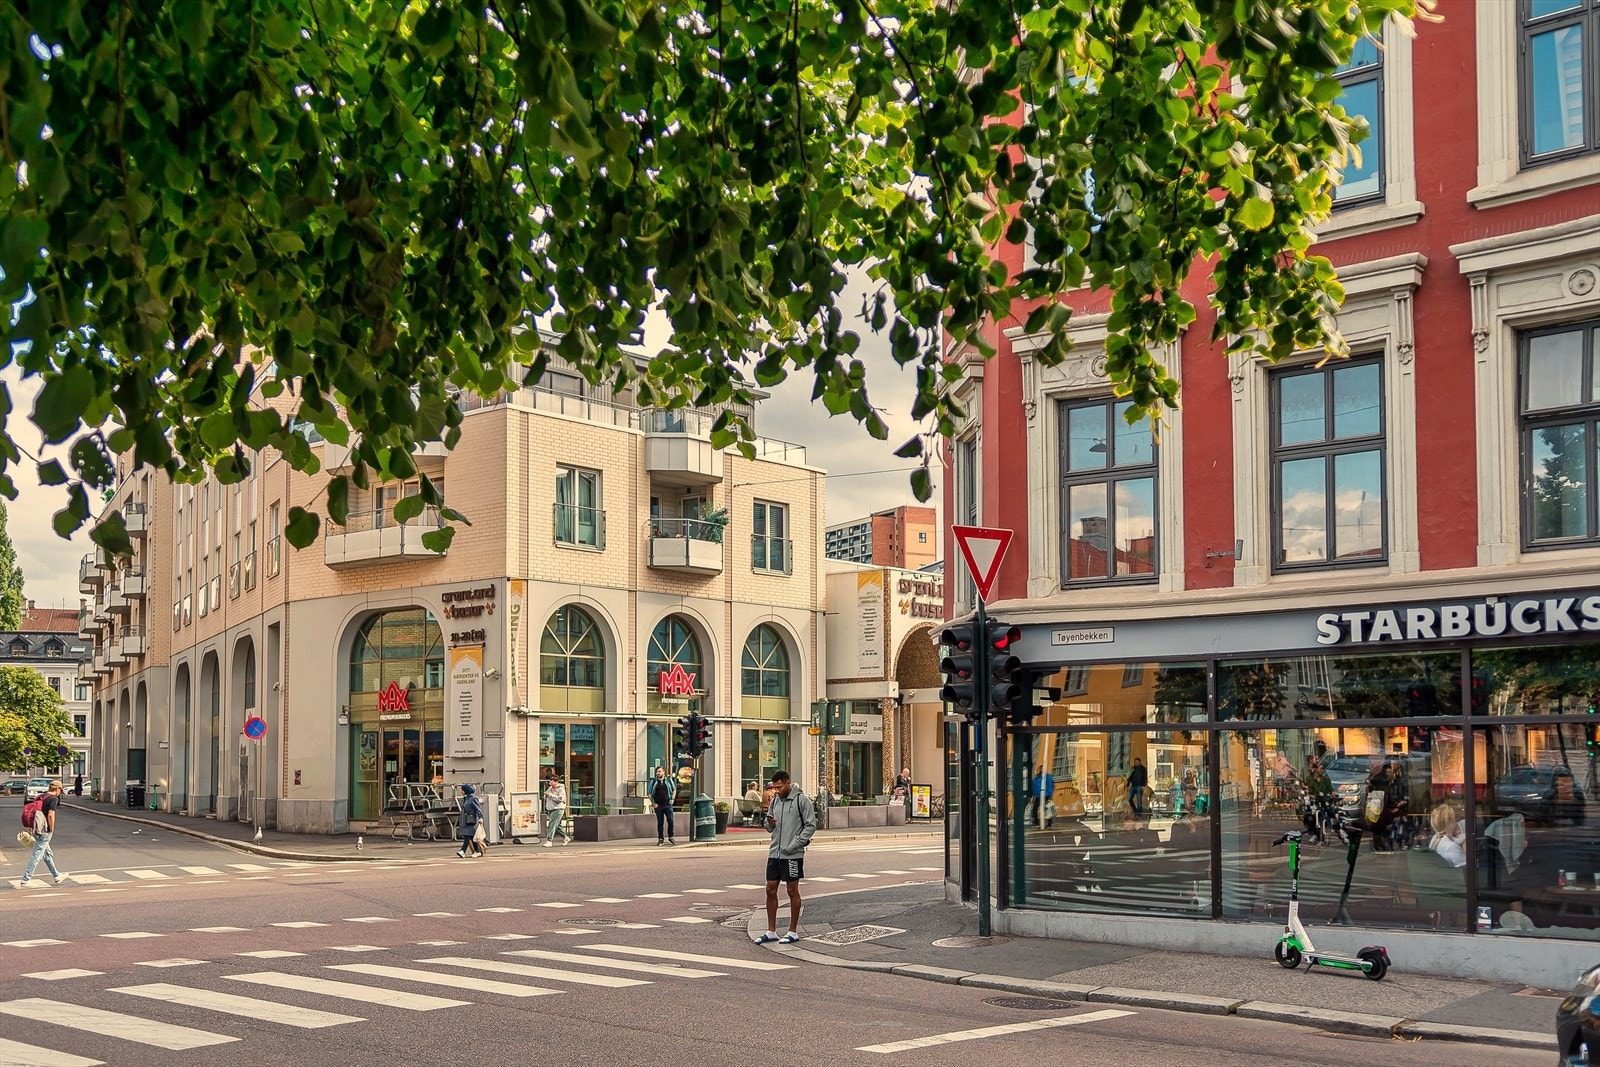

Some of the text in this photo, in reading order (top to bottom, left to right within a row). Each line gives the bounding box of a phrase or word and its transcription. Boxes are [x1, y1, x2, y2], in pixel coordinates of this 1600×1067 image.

[1316, 595, 1600, 645] STARBUCKS
[1057, 631, 1108, 643] Tøyenbekken
[659, 663, 696, 695] MAX
[378, 680, 410, 711] MAX
